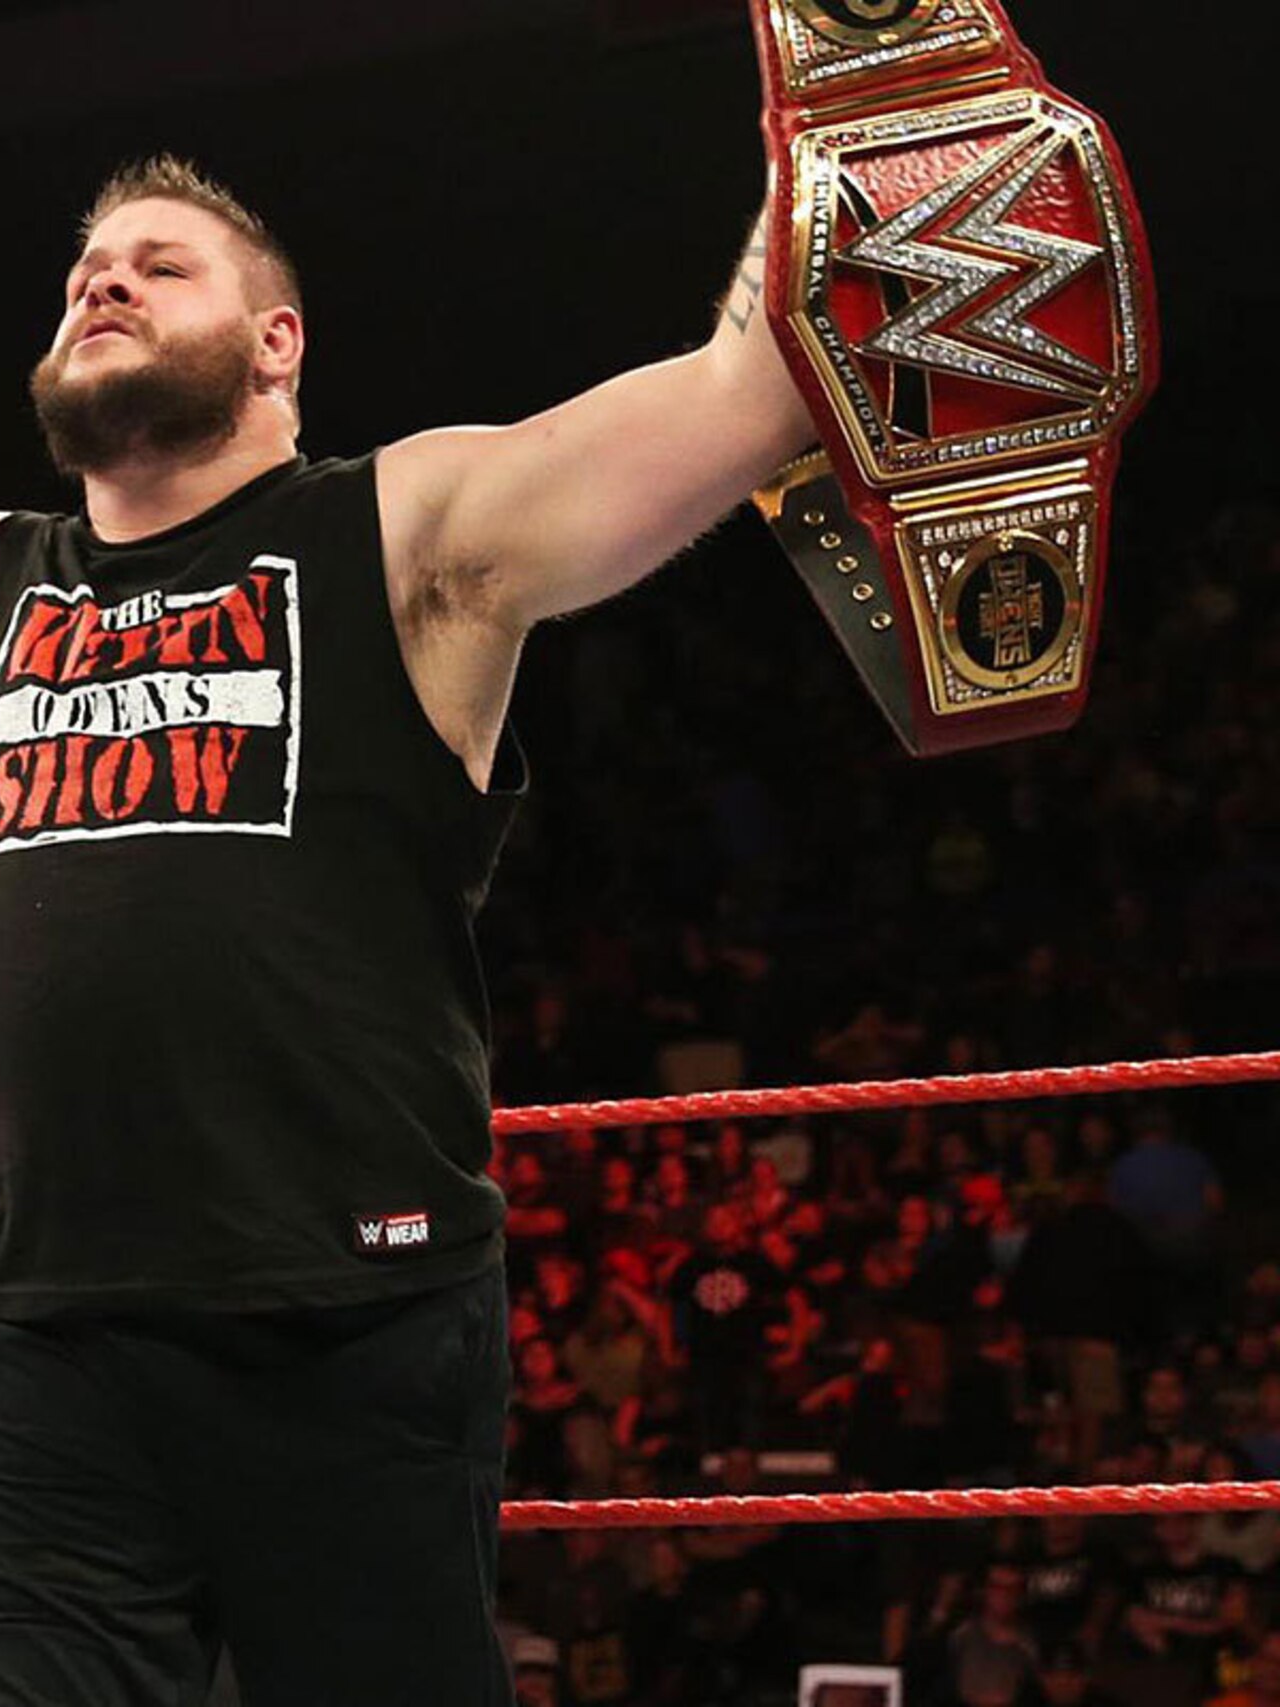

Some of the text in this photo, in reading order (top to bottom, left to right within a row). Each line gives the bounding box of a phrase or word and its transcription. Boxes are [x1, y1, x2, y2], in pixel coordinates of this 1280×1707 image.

[808, 168, 880, 437] NIVERSAL CHAMPION
[6, 575, 273, 683] KEVIN
[100, 590, 164, 630] THE
[33, 679, 210, 732] OWENS
[385, 1221, 429, 1245] WEAR
